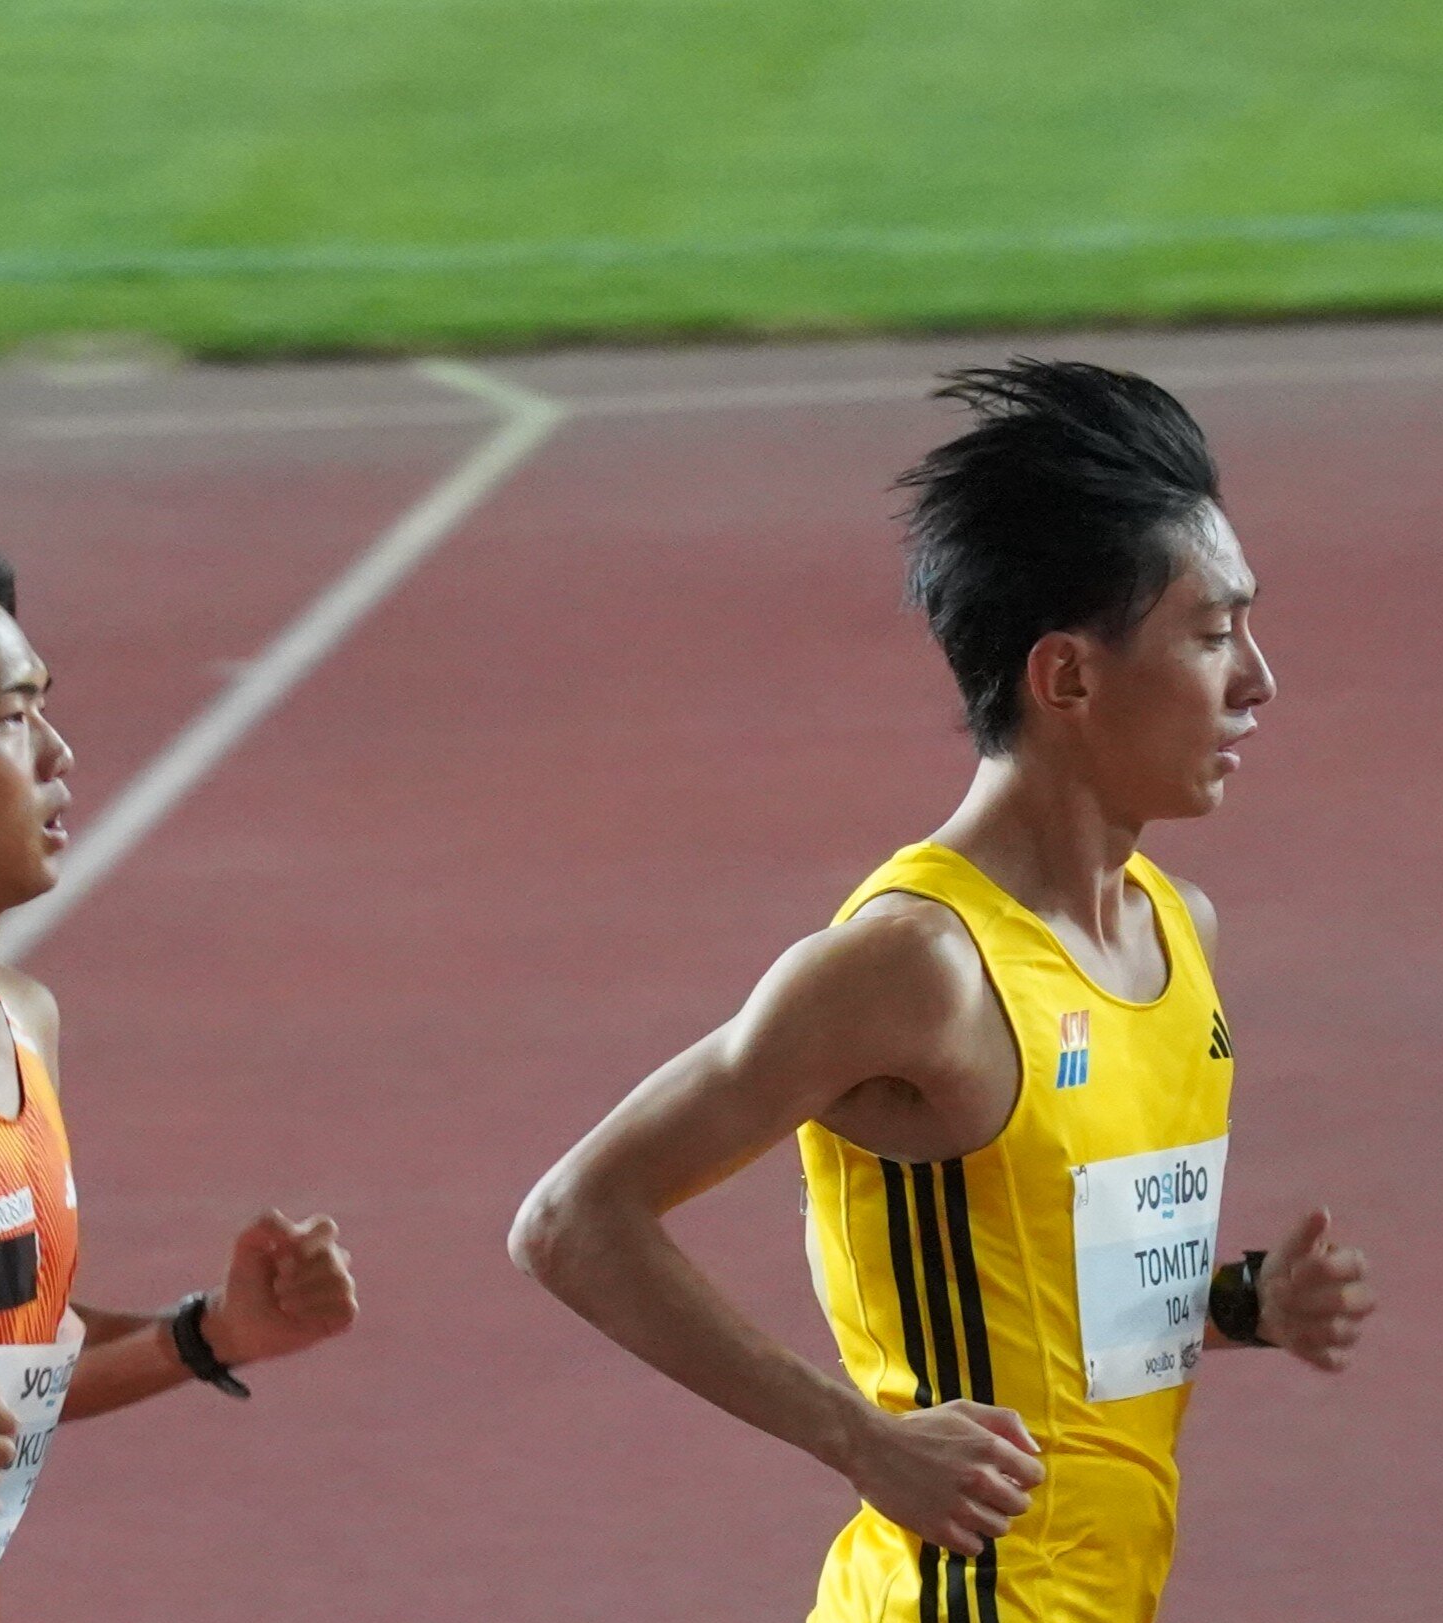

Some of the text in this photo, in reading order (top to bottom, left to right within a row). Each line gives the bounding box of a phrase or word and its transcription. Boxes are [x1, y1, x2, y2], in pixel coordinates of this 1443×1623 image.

[1134, 1160, 1208, 1219] yogibo
[1134, 1237, 1211, 1288] TOMITA
[1165, 1294, 1190, 1327] 104
